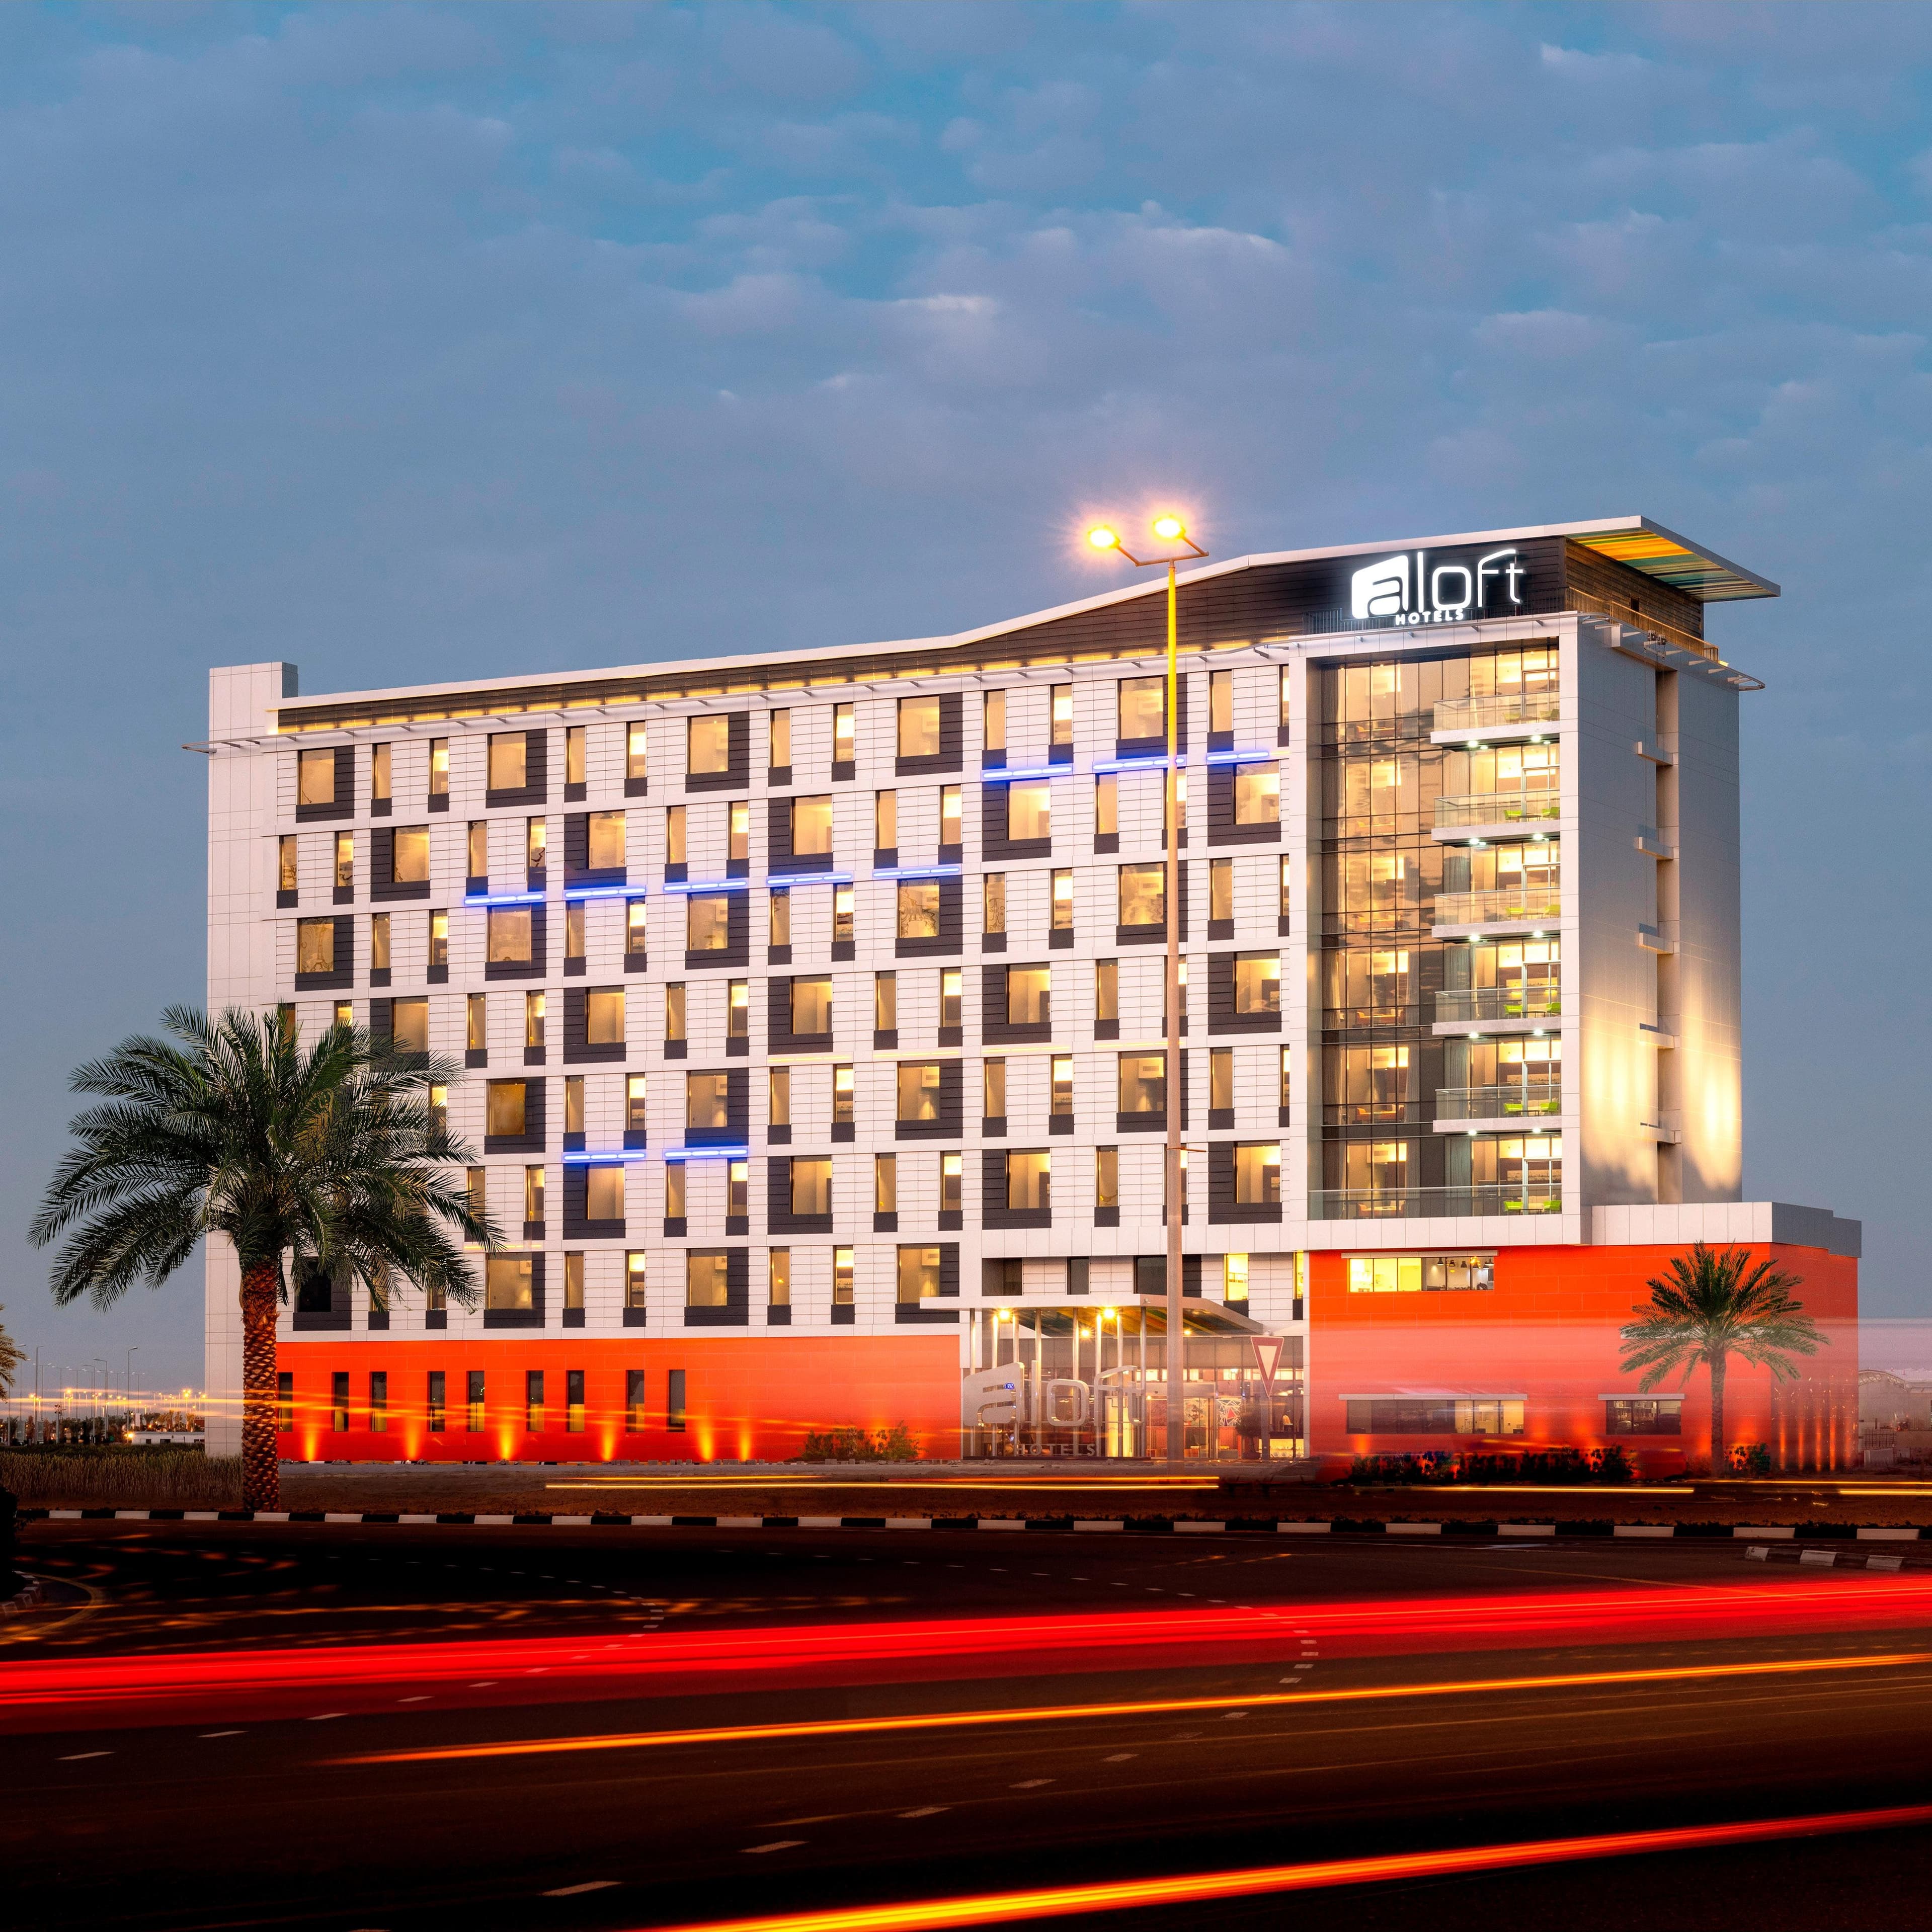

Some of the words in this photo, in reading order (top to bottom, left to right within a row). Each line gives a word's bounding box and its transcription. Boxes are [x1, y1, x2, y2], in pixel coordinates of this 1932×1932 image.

[1351, 548, 1524, 619] aloft
[1395, 609, 1464, 625] HOTELS
[963, 1360, 1145, 1427] aloft
[1015, 1443, 1095, 1456] HOTELS
